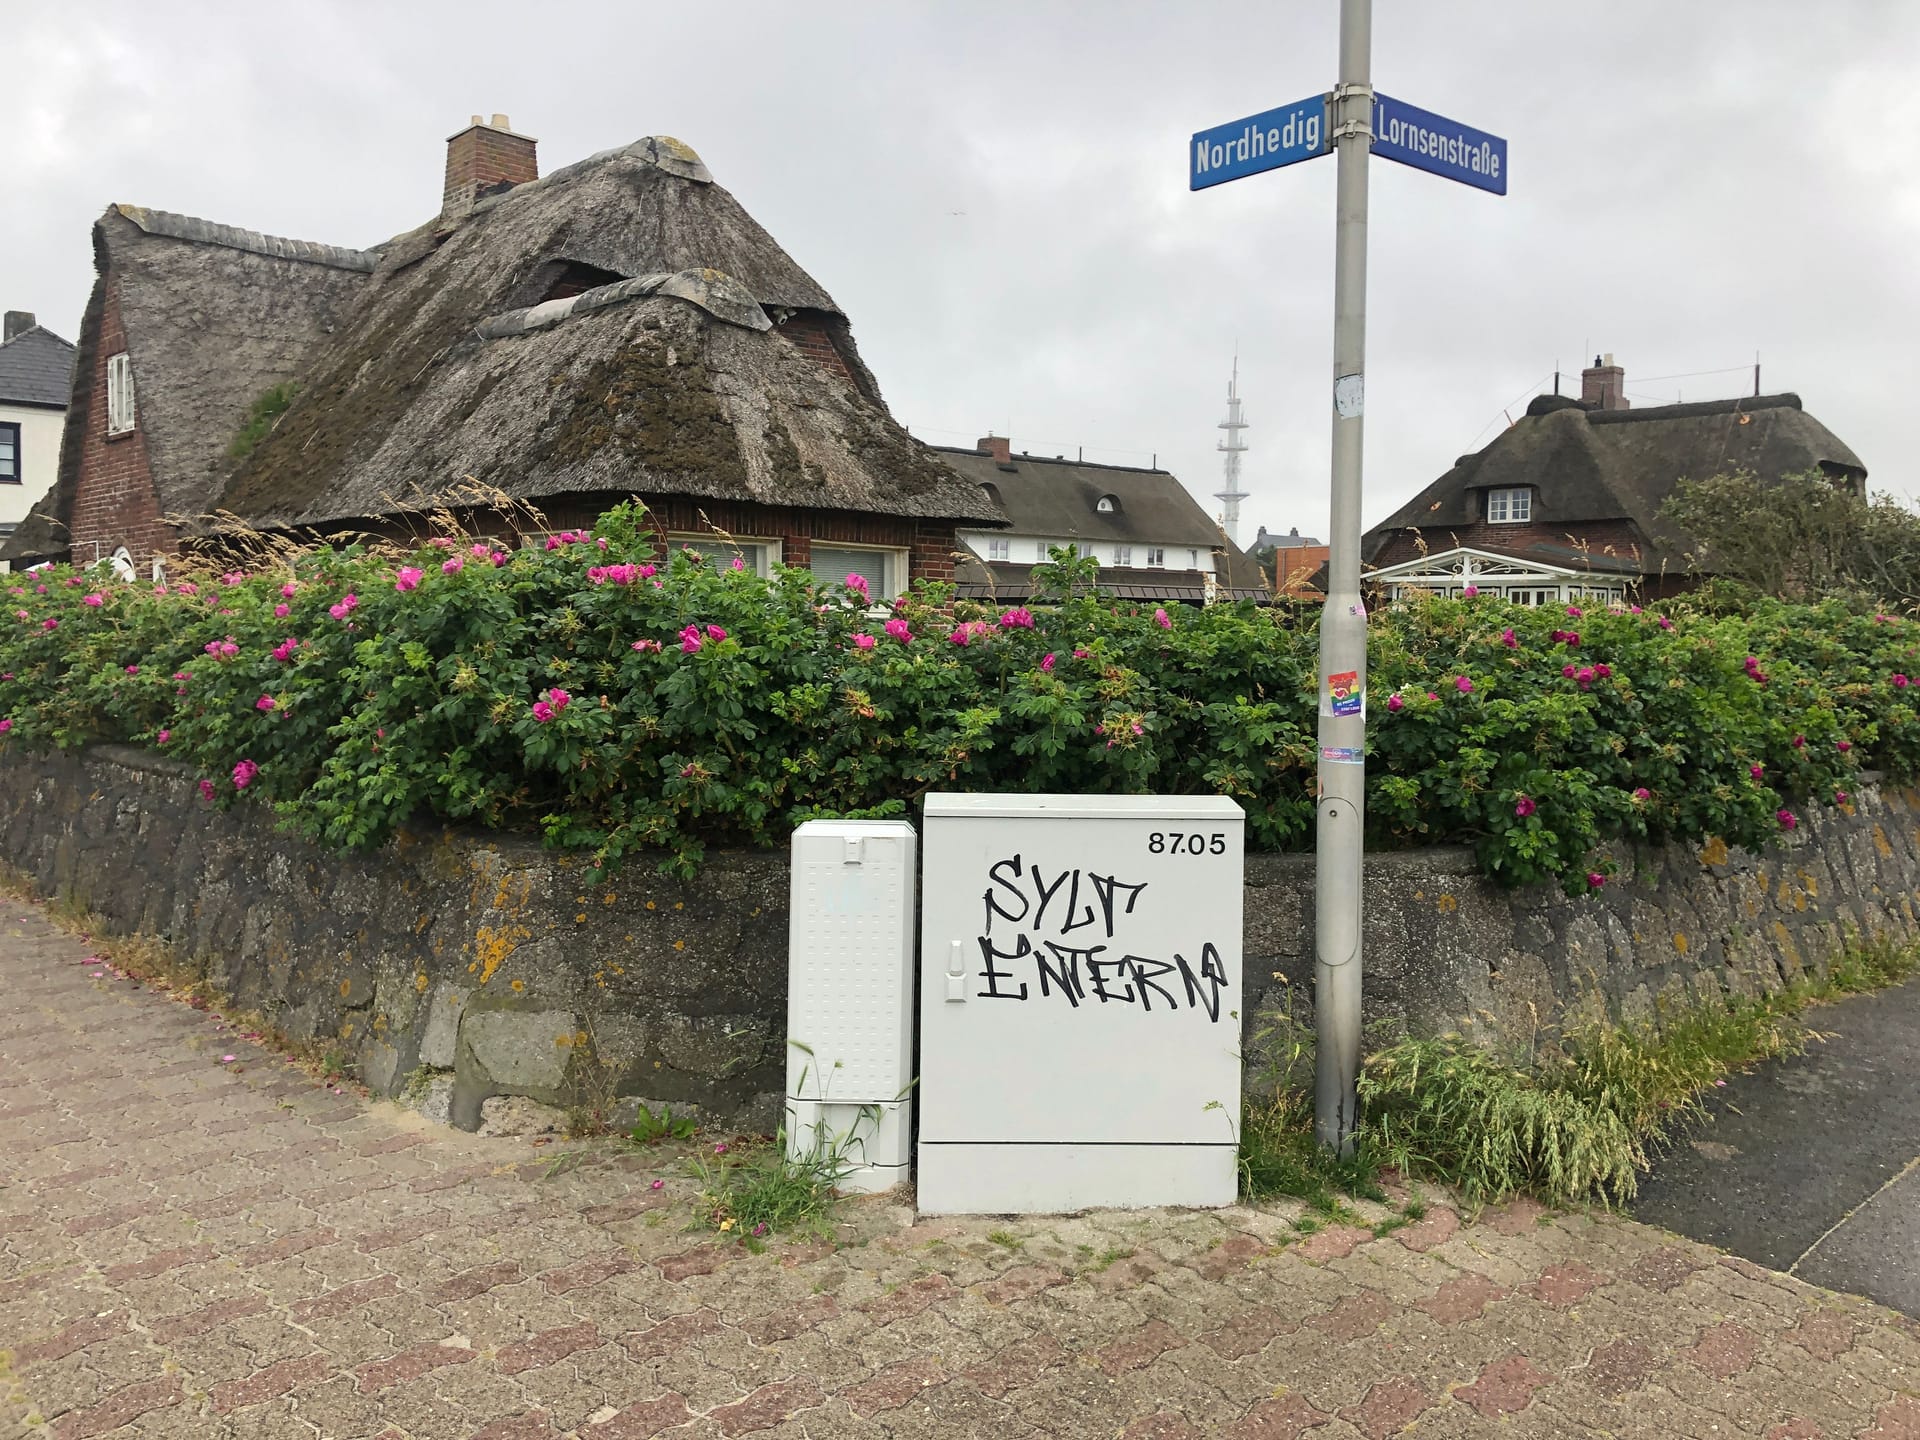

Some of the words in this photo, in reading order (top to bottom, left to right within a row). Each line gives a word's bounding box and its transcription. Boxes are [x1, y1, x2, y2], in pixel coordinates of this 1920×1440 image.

[1196, 110, 1320, 174] Nordhedig
[1379, 104, 1500, 178] Lornsenstraße
[1148, 832, 1226, 855] 87.05
[982, 854, 1148, 937] SYLT
[977, 933, 1229, 1023] ENTERN
